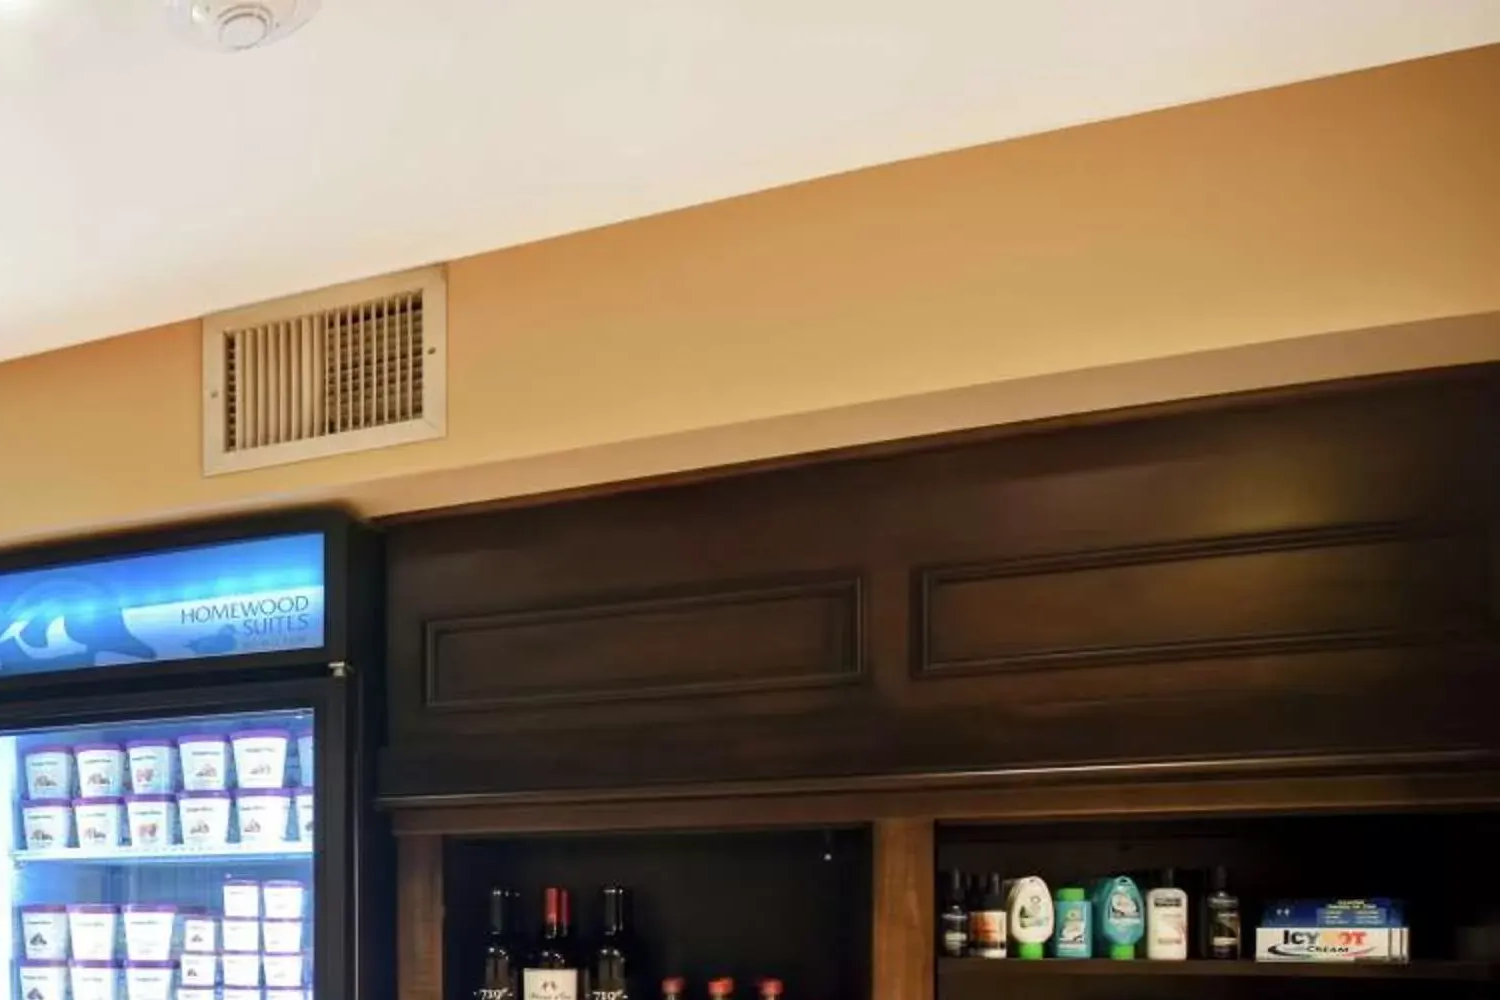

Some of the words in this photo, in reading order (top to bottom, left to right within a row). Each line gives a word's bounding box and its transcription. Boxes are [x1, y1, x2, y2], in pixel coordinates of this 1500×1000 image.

[180, 596, 309, 624] HOMEWOOD
[243, 614, 309, 636] SUITES
[1283, 930, 1319, 945] ICY
